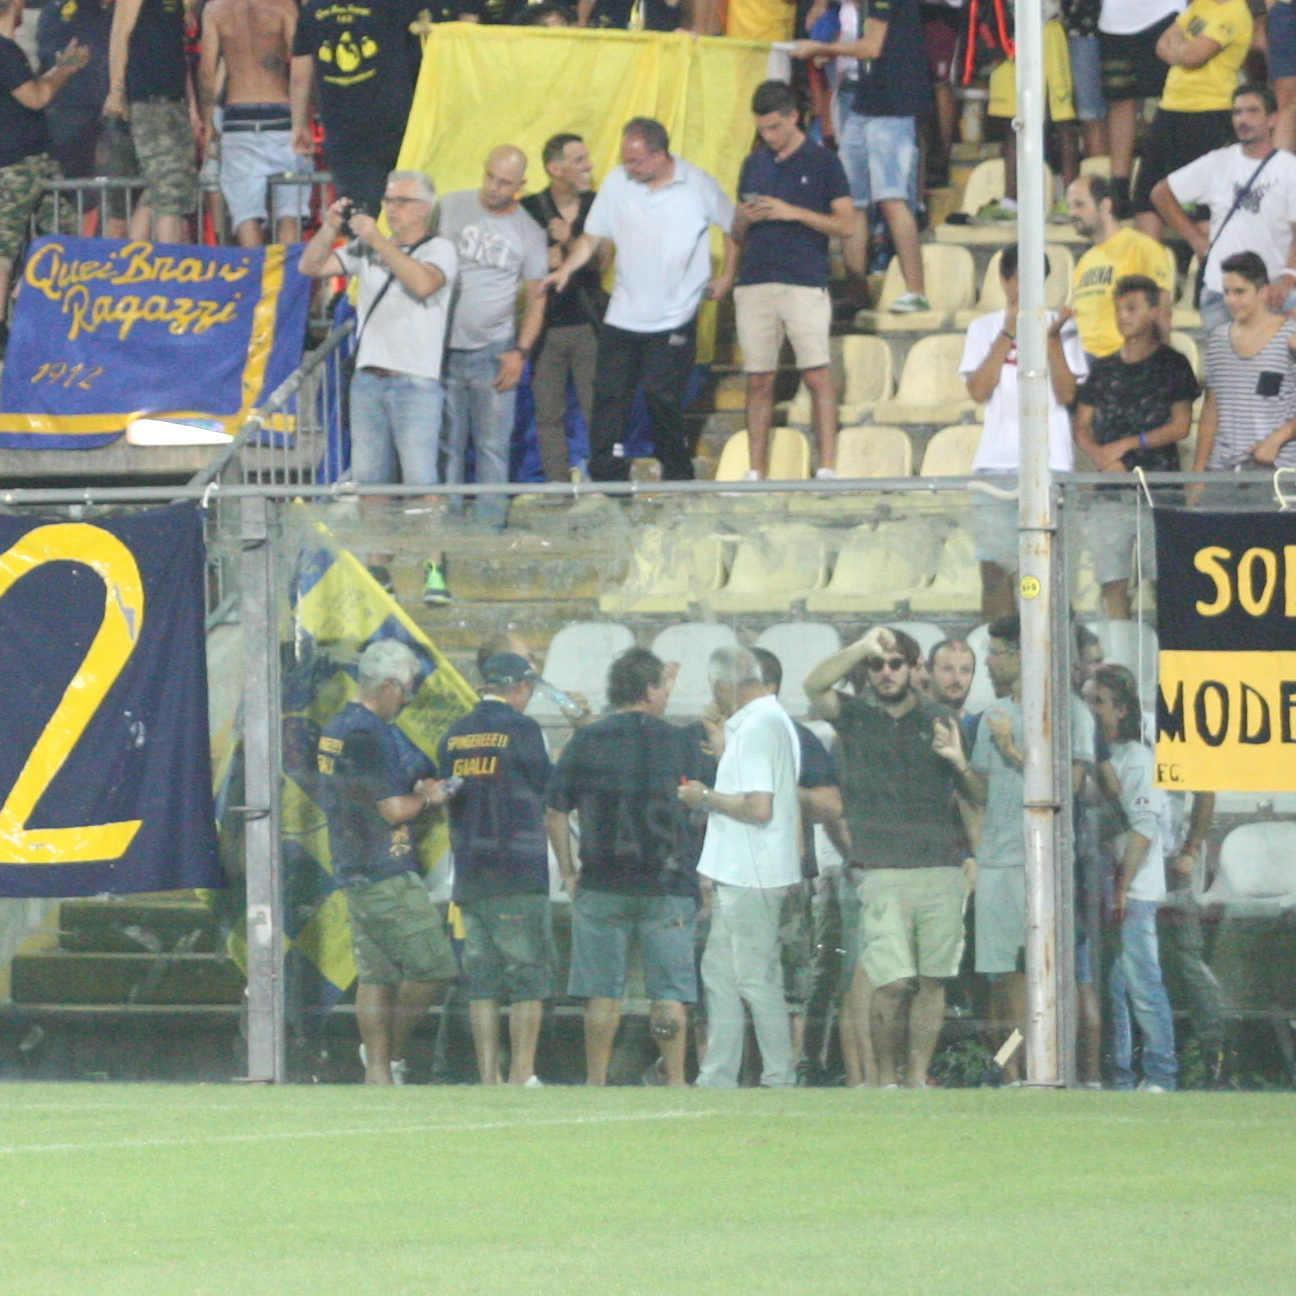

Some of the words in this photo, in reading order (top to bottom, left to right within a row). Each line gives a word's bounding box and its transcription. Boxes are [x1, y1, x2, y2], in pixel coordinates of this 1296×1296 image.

[24, 242, 117, 300] Quei
[61, 284, 244, 341] Ragazzi
[30, 361, 104, 390] 1912
